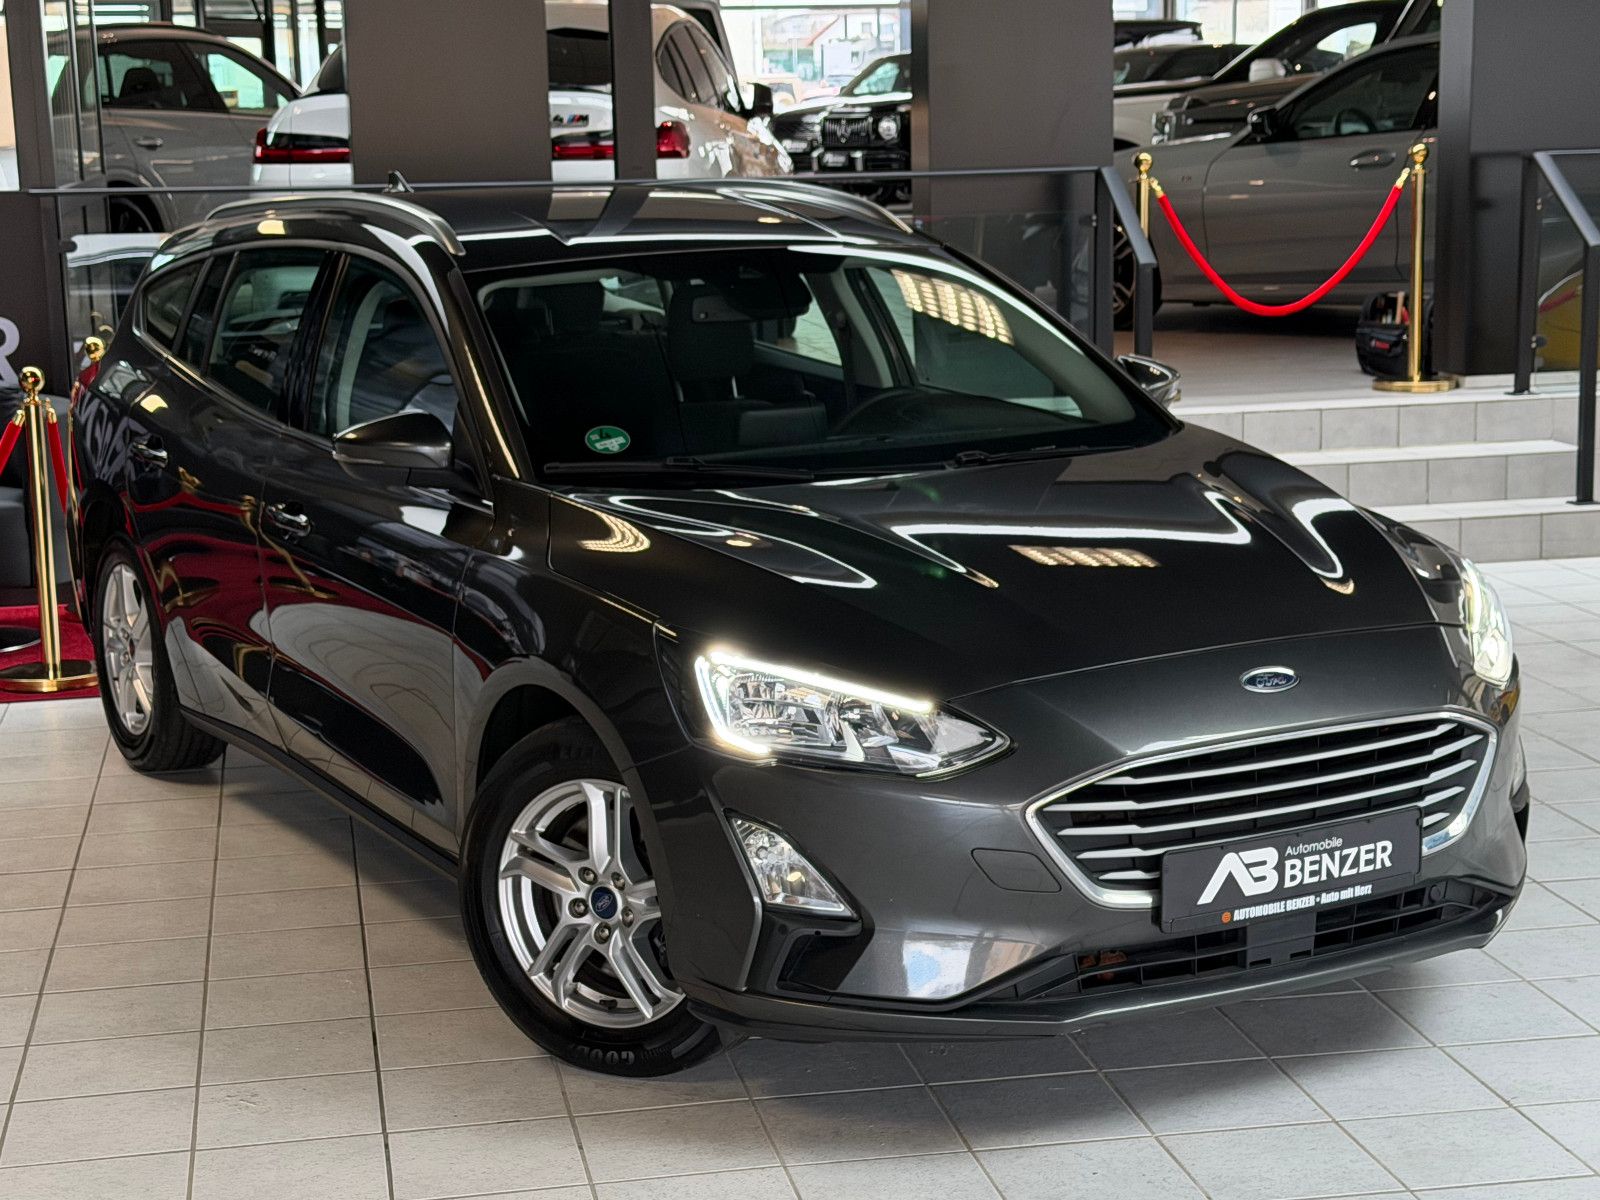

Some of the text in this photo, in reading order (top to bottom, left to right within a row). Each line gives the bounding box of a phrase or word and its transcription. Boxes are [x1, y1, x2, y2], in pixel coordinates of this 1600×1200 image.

[1283, 840, 1393, 889] BENZER
[1284, 836, 1343, 857] Automobile
[1233, 884, 1373, 921] AUTOMOBILE BENZER Auto mit Herz
